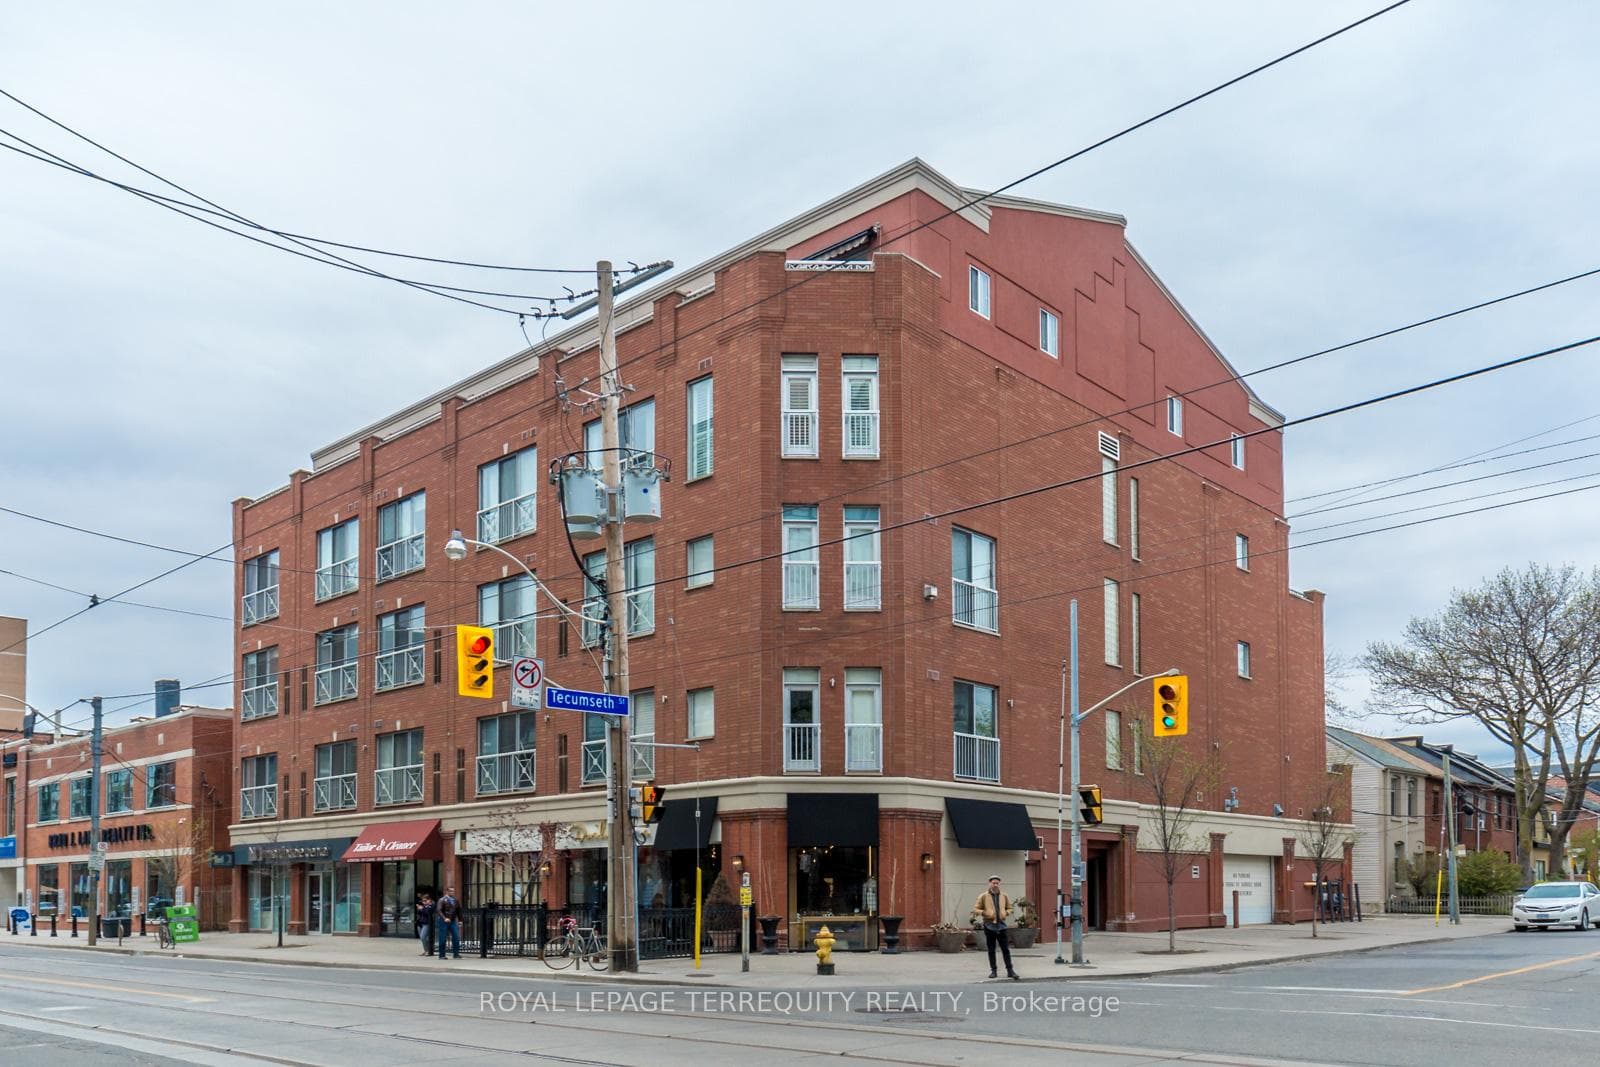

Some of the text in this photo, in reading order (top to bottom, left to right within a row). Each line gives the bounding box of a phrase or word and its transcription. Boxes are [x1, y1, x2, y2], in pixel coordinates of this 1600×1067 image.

[551, 690, 615, 709] Tecumseth
[352, 842, 376, 852] Tailor
[385, 841, 418, 851] Cleaner
